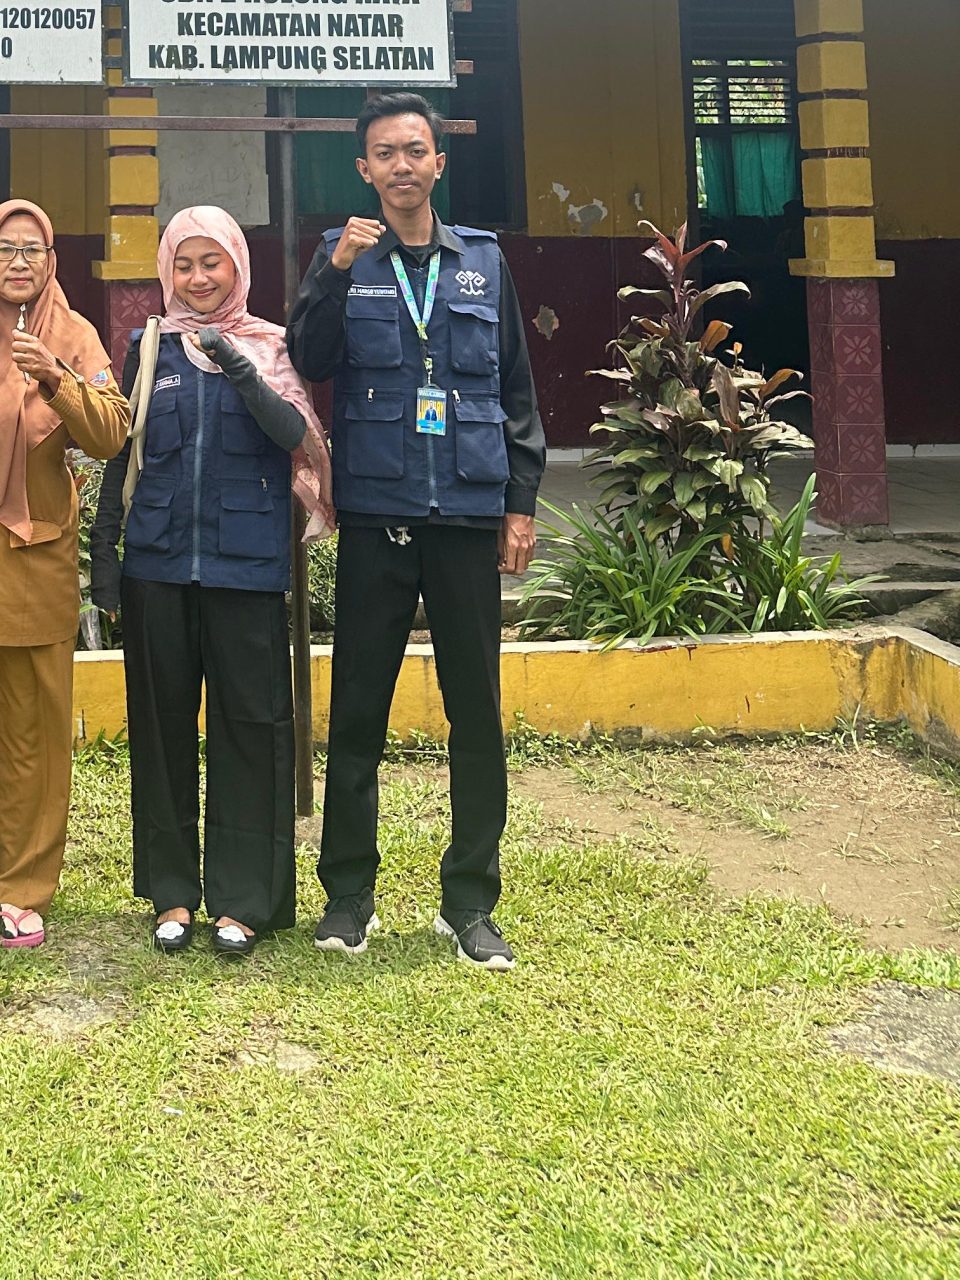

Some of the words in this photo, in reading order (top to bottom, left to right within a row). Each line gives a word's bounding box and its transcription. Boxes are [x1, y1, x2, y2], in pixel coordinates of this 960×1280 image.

[178, 12, 320, 36] KECAMATAN
[328, 14, 403, 37] NATAR
[149, 45, 204, 70] KAB.
[211, 45, 326, 70] LAMPUNG
[333, 46, 434, 70] SELATAN
